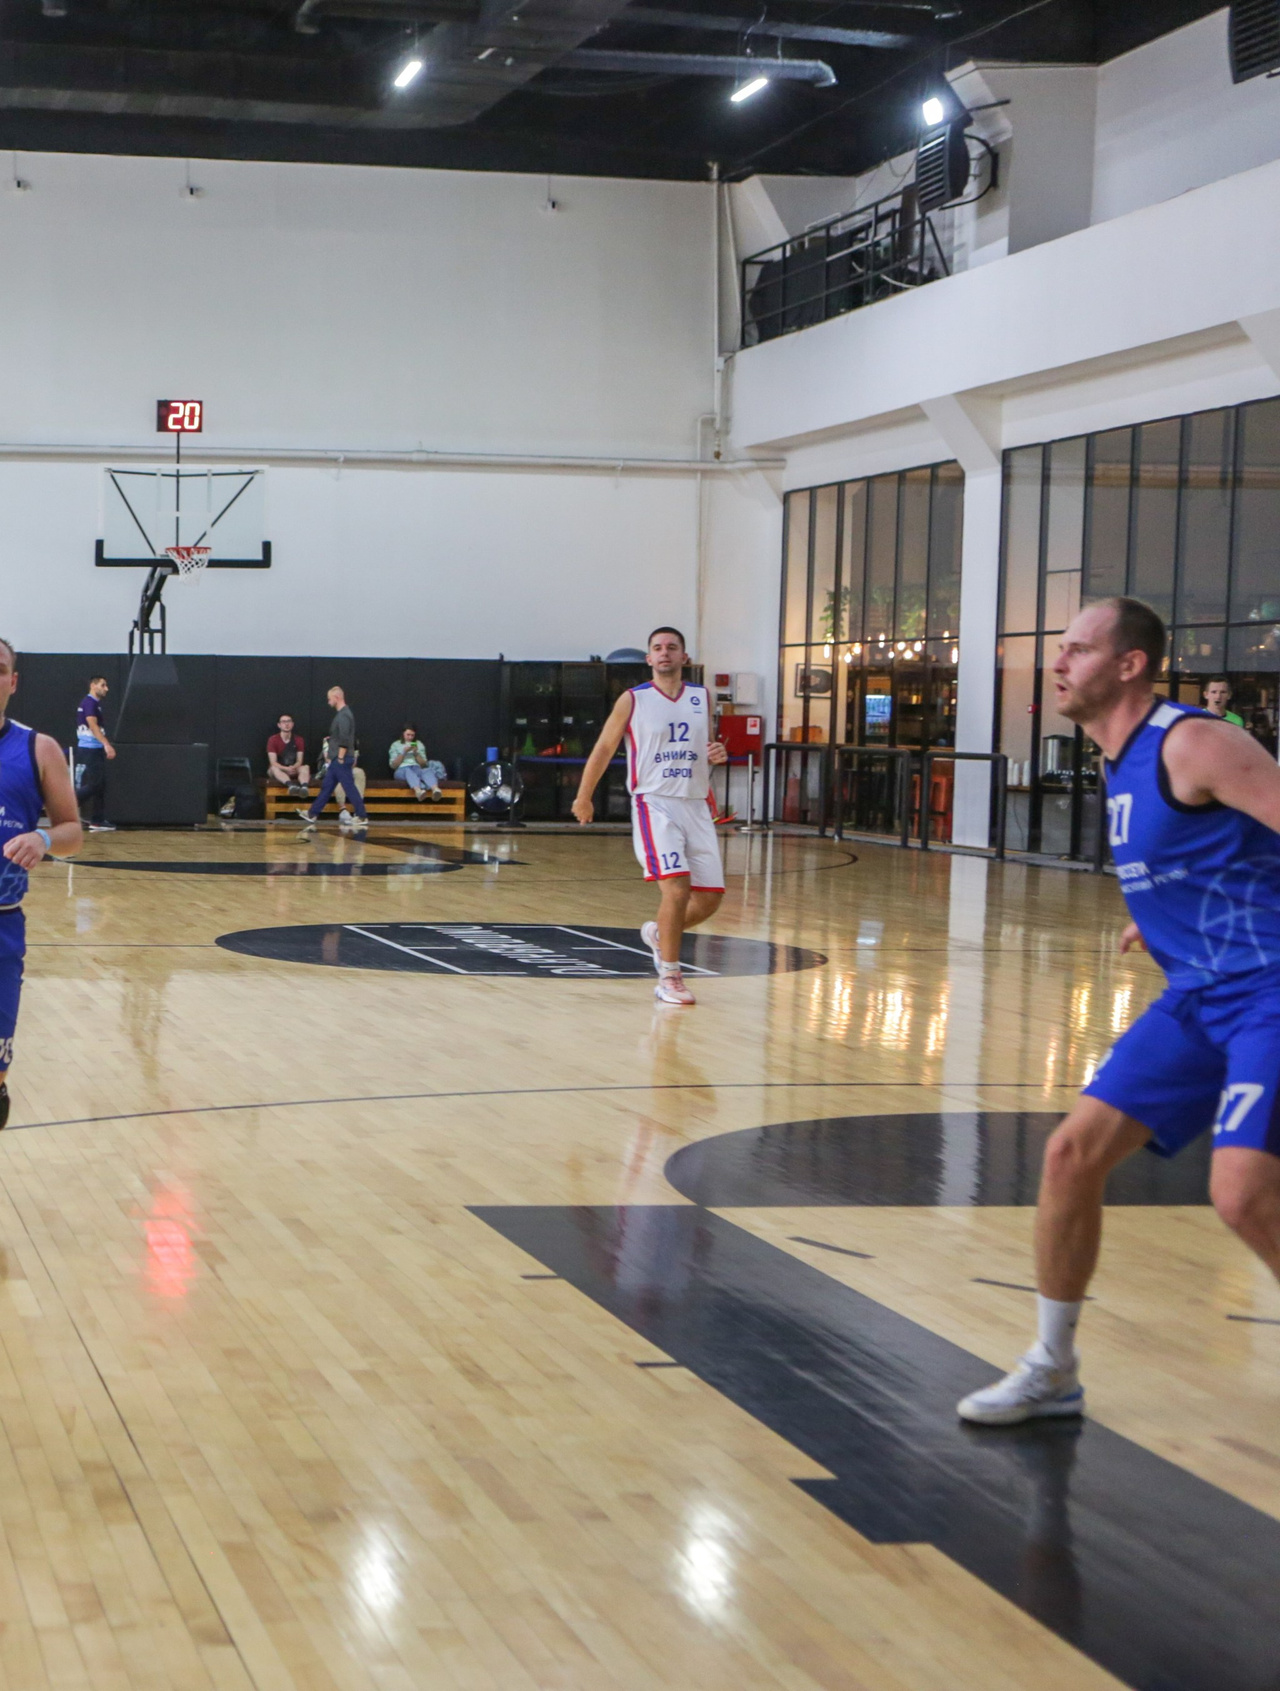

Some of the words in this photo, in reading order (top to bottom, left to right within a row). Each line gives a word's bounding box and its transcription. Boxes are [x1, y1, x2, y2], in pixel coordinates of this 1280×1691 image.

[167, 402, 201, 430] 20
[668, 722, 690, 743] 12
[1106, 793, 1133, 847] 27
[661, 851, 682, 871] 12
